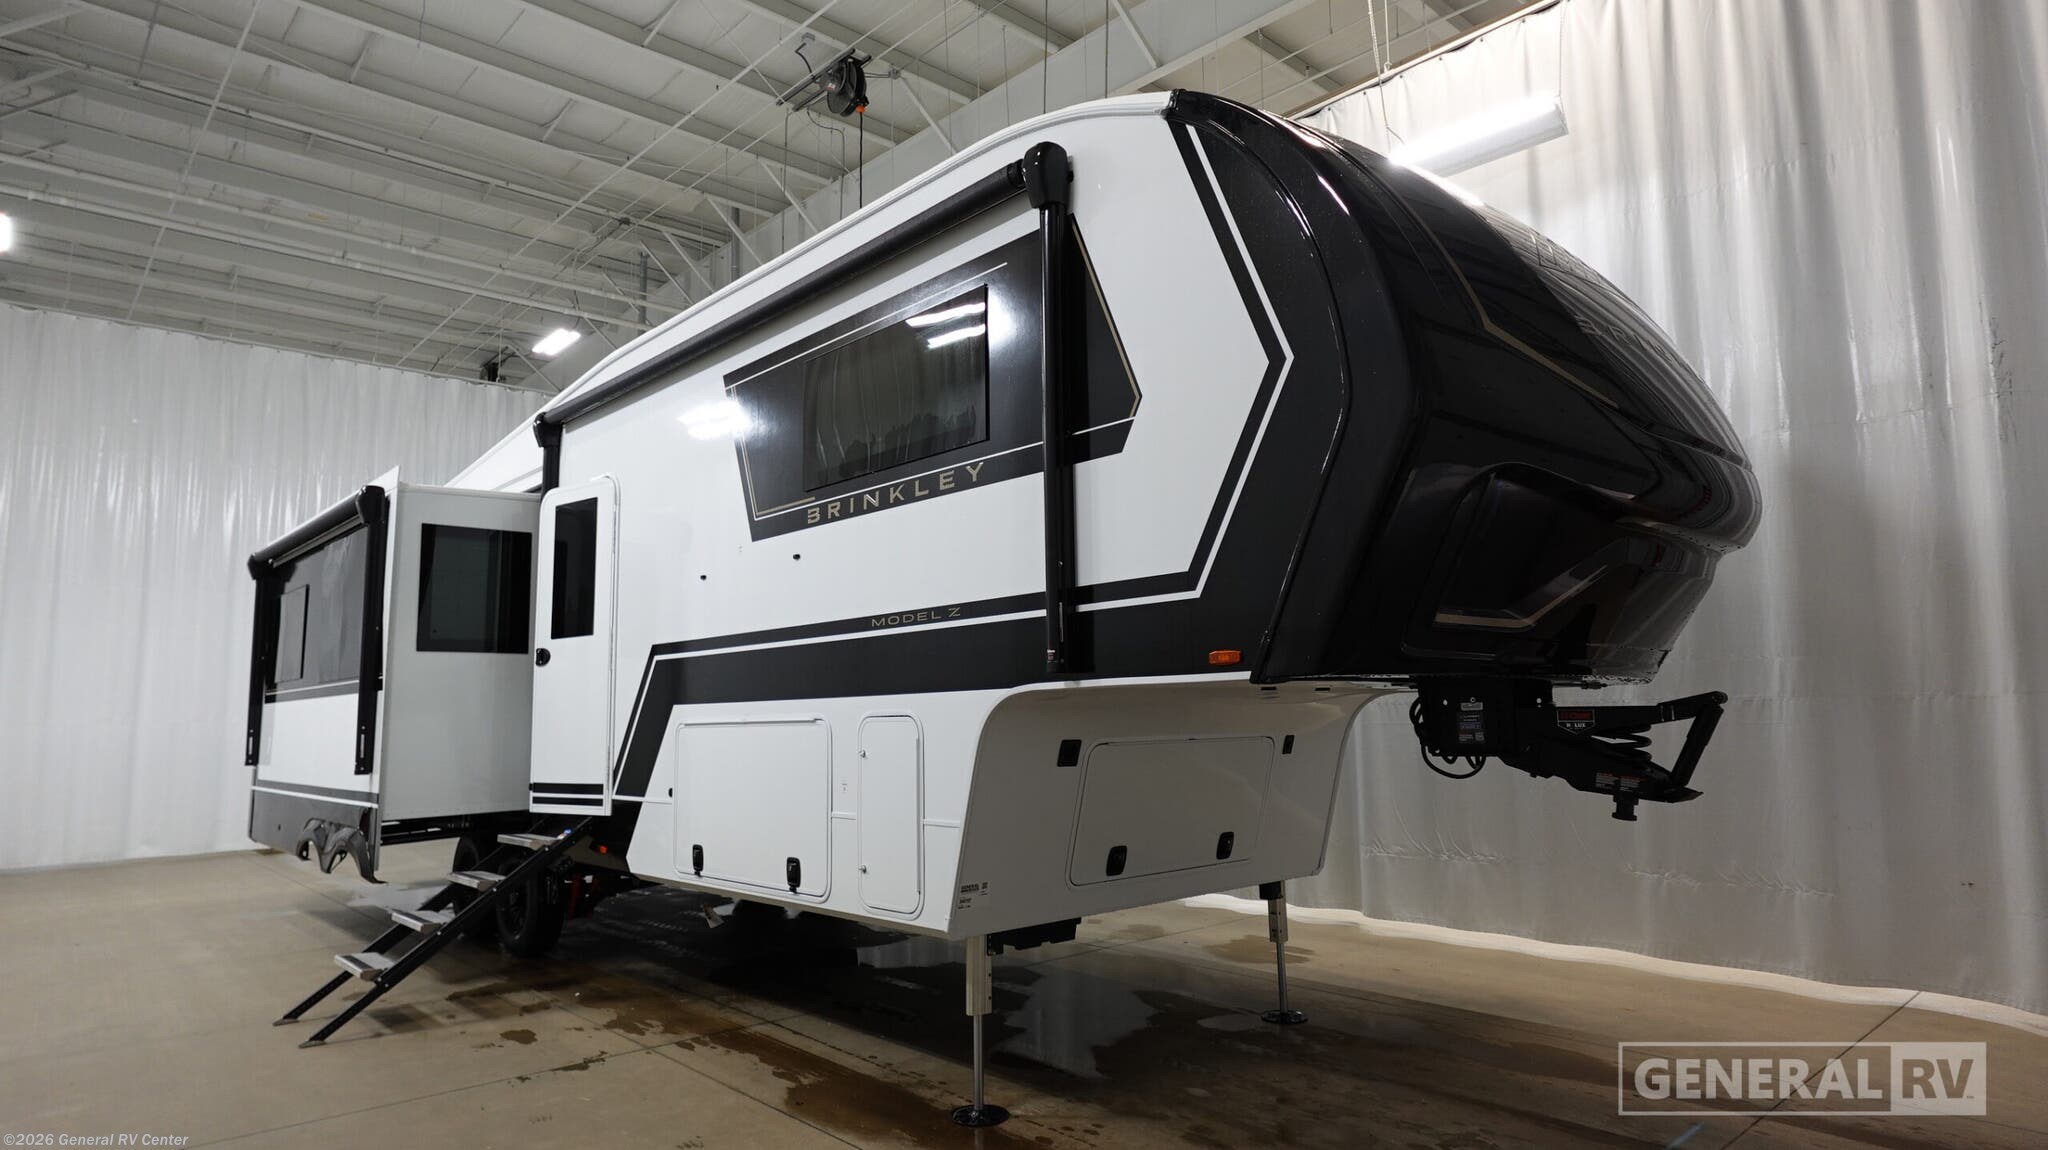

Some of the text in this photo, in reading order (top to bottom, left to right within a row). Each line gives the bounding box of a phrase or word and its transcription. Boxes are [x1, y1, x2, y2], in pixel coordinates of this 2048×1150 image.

[807, 462, 985, 524] BRINKLEY
[871, 607, 961, 627] MODEL Z
